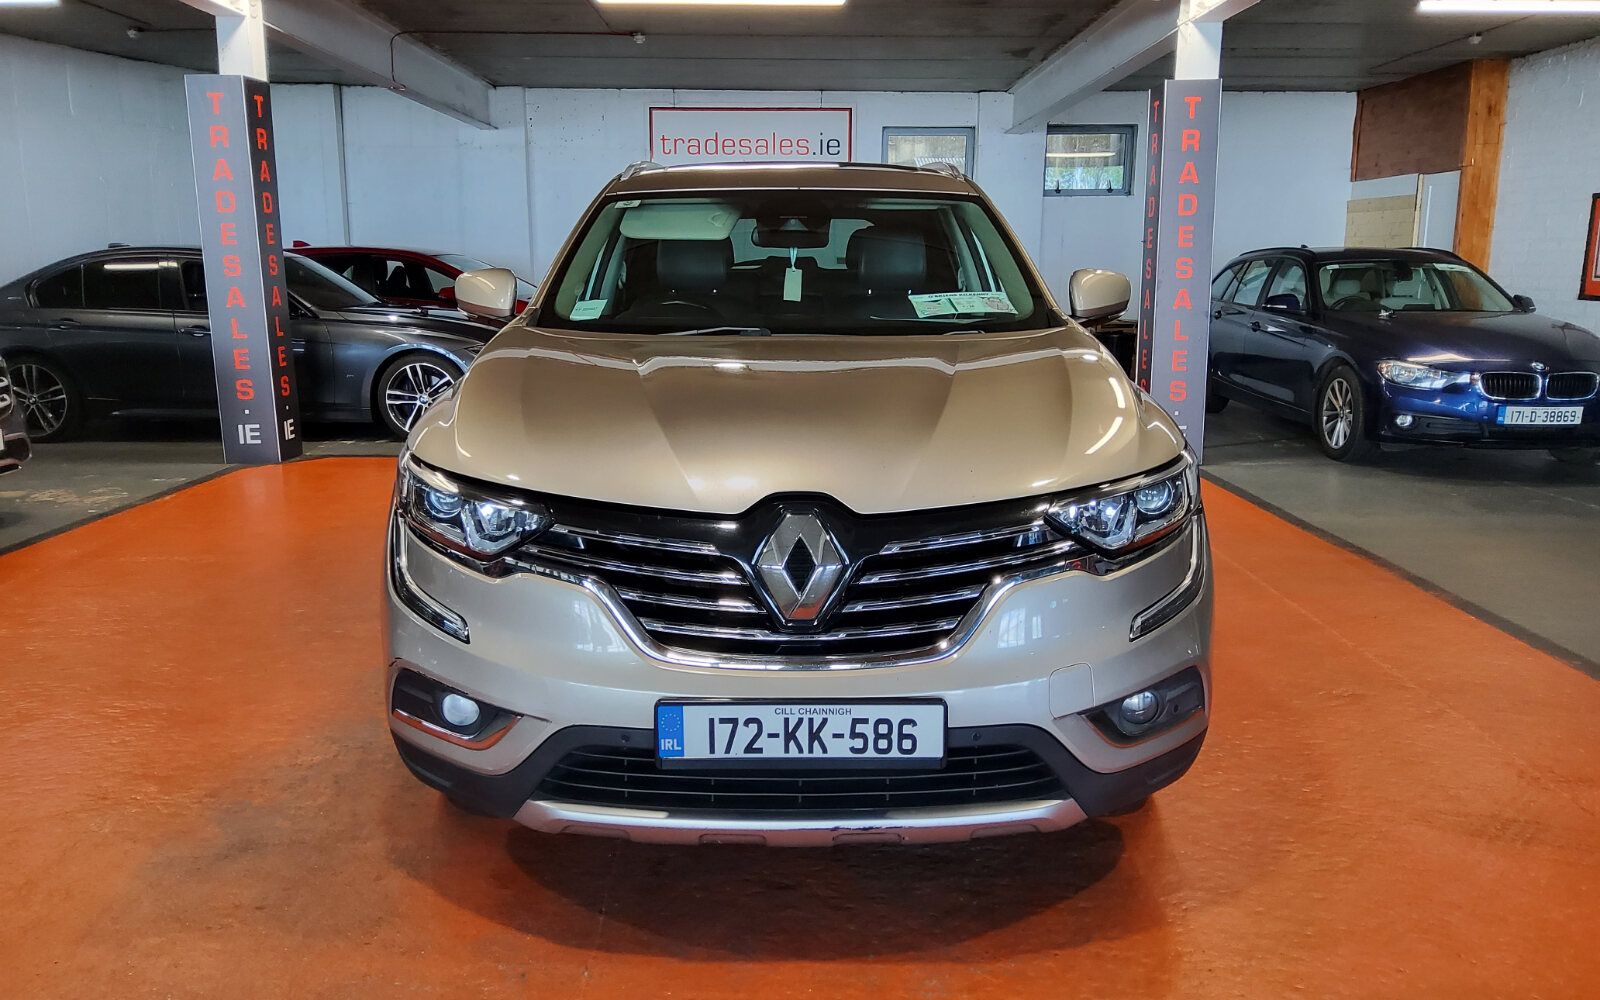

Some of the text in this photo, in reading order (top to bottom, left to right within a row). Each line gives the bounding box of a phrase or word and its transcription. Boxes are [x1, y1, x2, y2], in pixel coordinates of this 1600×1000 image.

[660, 131, 841, 156] tradesales.ie
[1510, 410, 1577, 423] 171-D-38869
[774, 707, 852, 716] CILL CHAINNIGH
[708, 717, 918, 755] 172-KK-586
[660, 738, 682, 751] IRL
